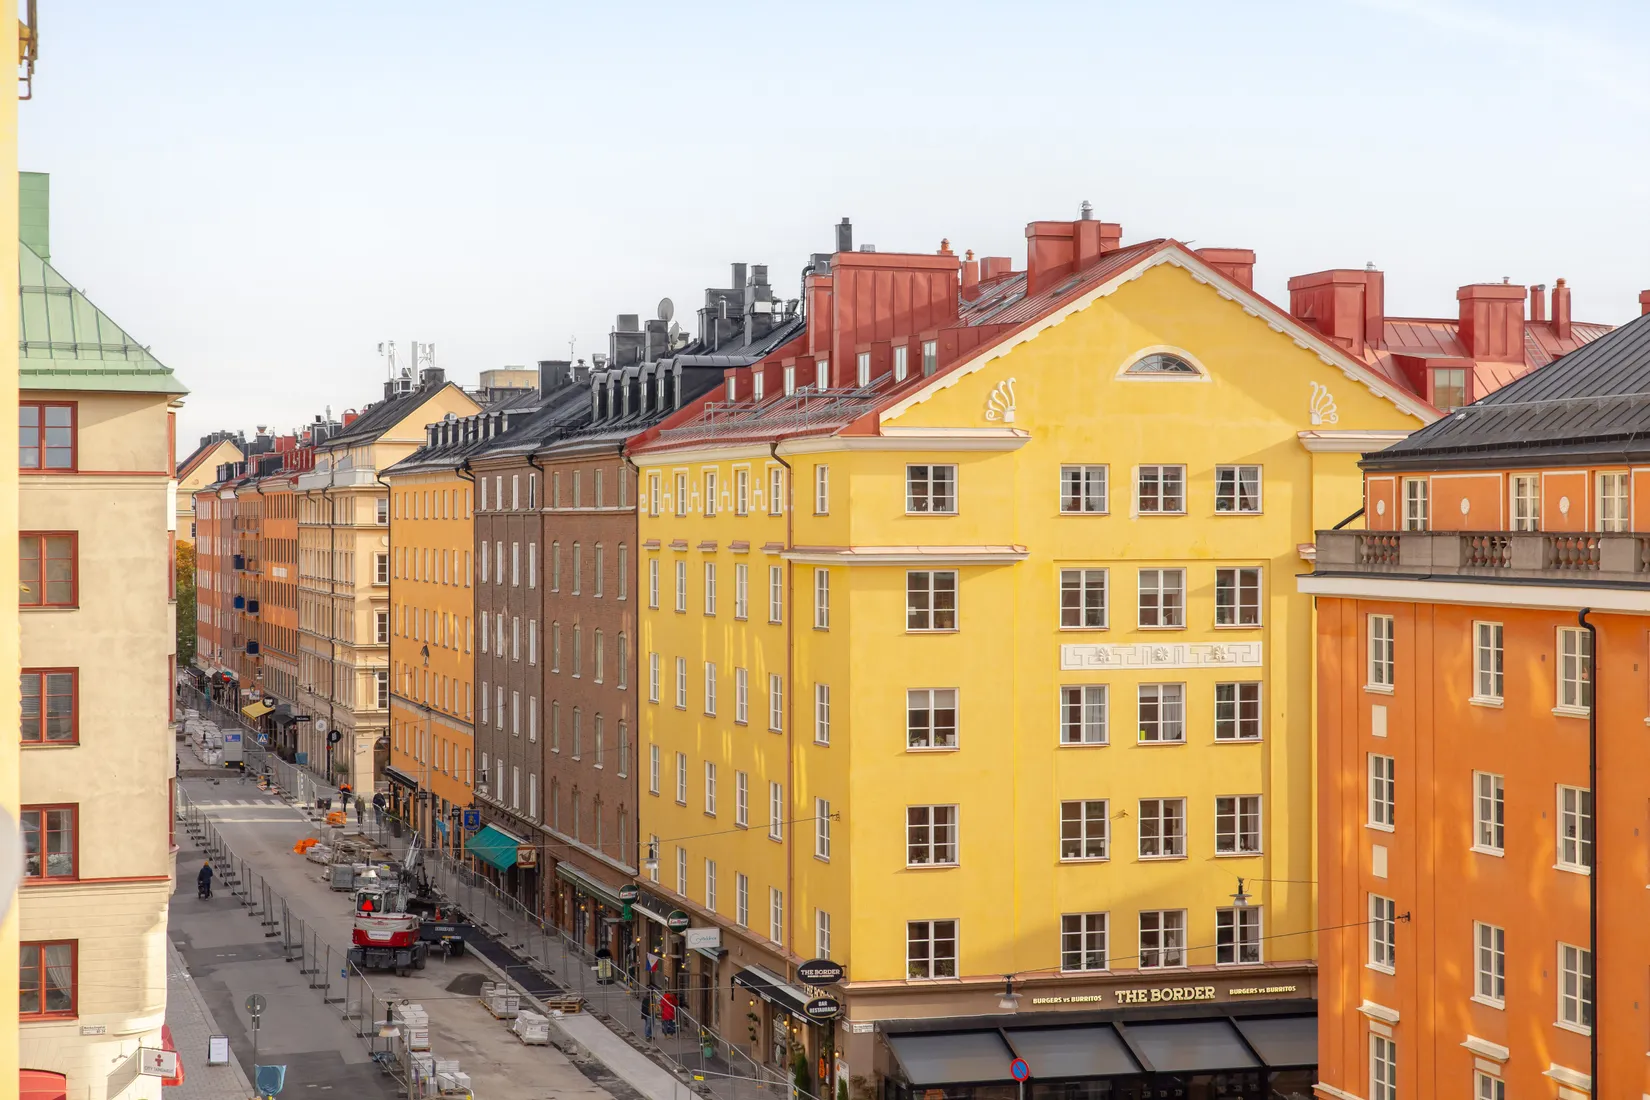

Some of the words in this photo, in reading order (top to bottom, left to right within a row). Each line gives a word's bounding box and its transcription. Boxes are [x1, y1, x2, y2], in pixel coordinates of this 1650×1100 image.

[1266, 985, 1296, 993] BURRITOS
[1071, 995, 1102, 1003] BURRITOS
[1114, 989, 1148, 1004] THE
[1150, 986, 1216, 1002] BORDER
